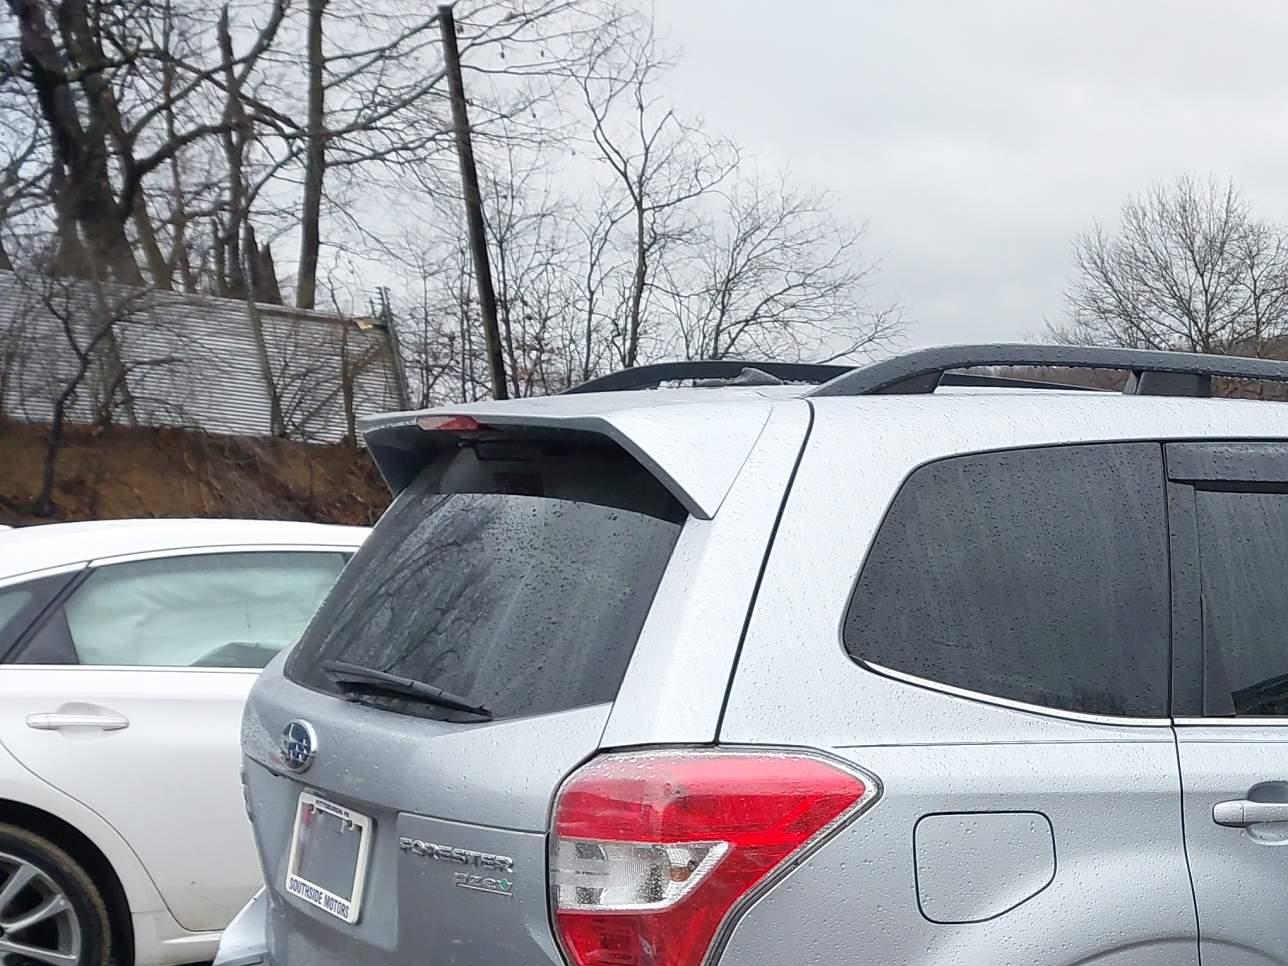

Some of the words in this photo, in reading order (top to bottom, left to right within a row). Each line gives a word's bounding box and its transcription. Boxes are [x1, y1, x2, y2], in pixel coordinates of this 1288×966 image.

[399, 837, 514, 873] FORESTER
[288, 877, 323, 905] SOUTHSIDE
[324, 893, 350, 919] MOTORS
